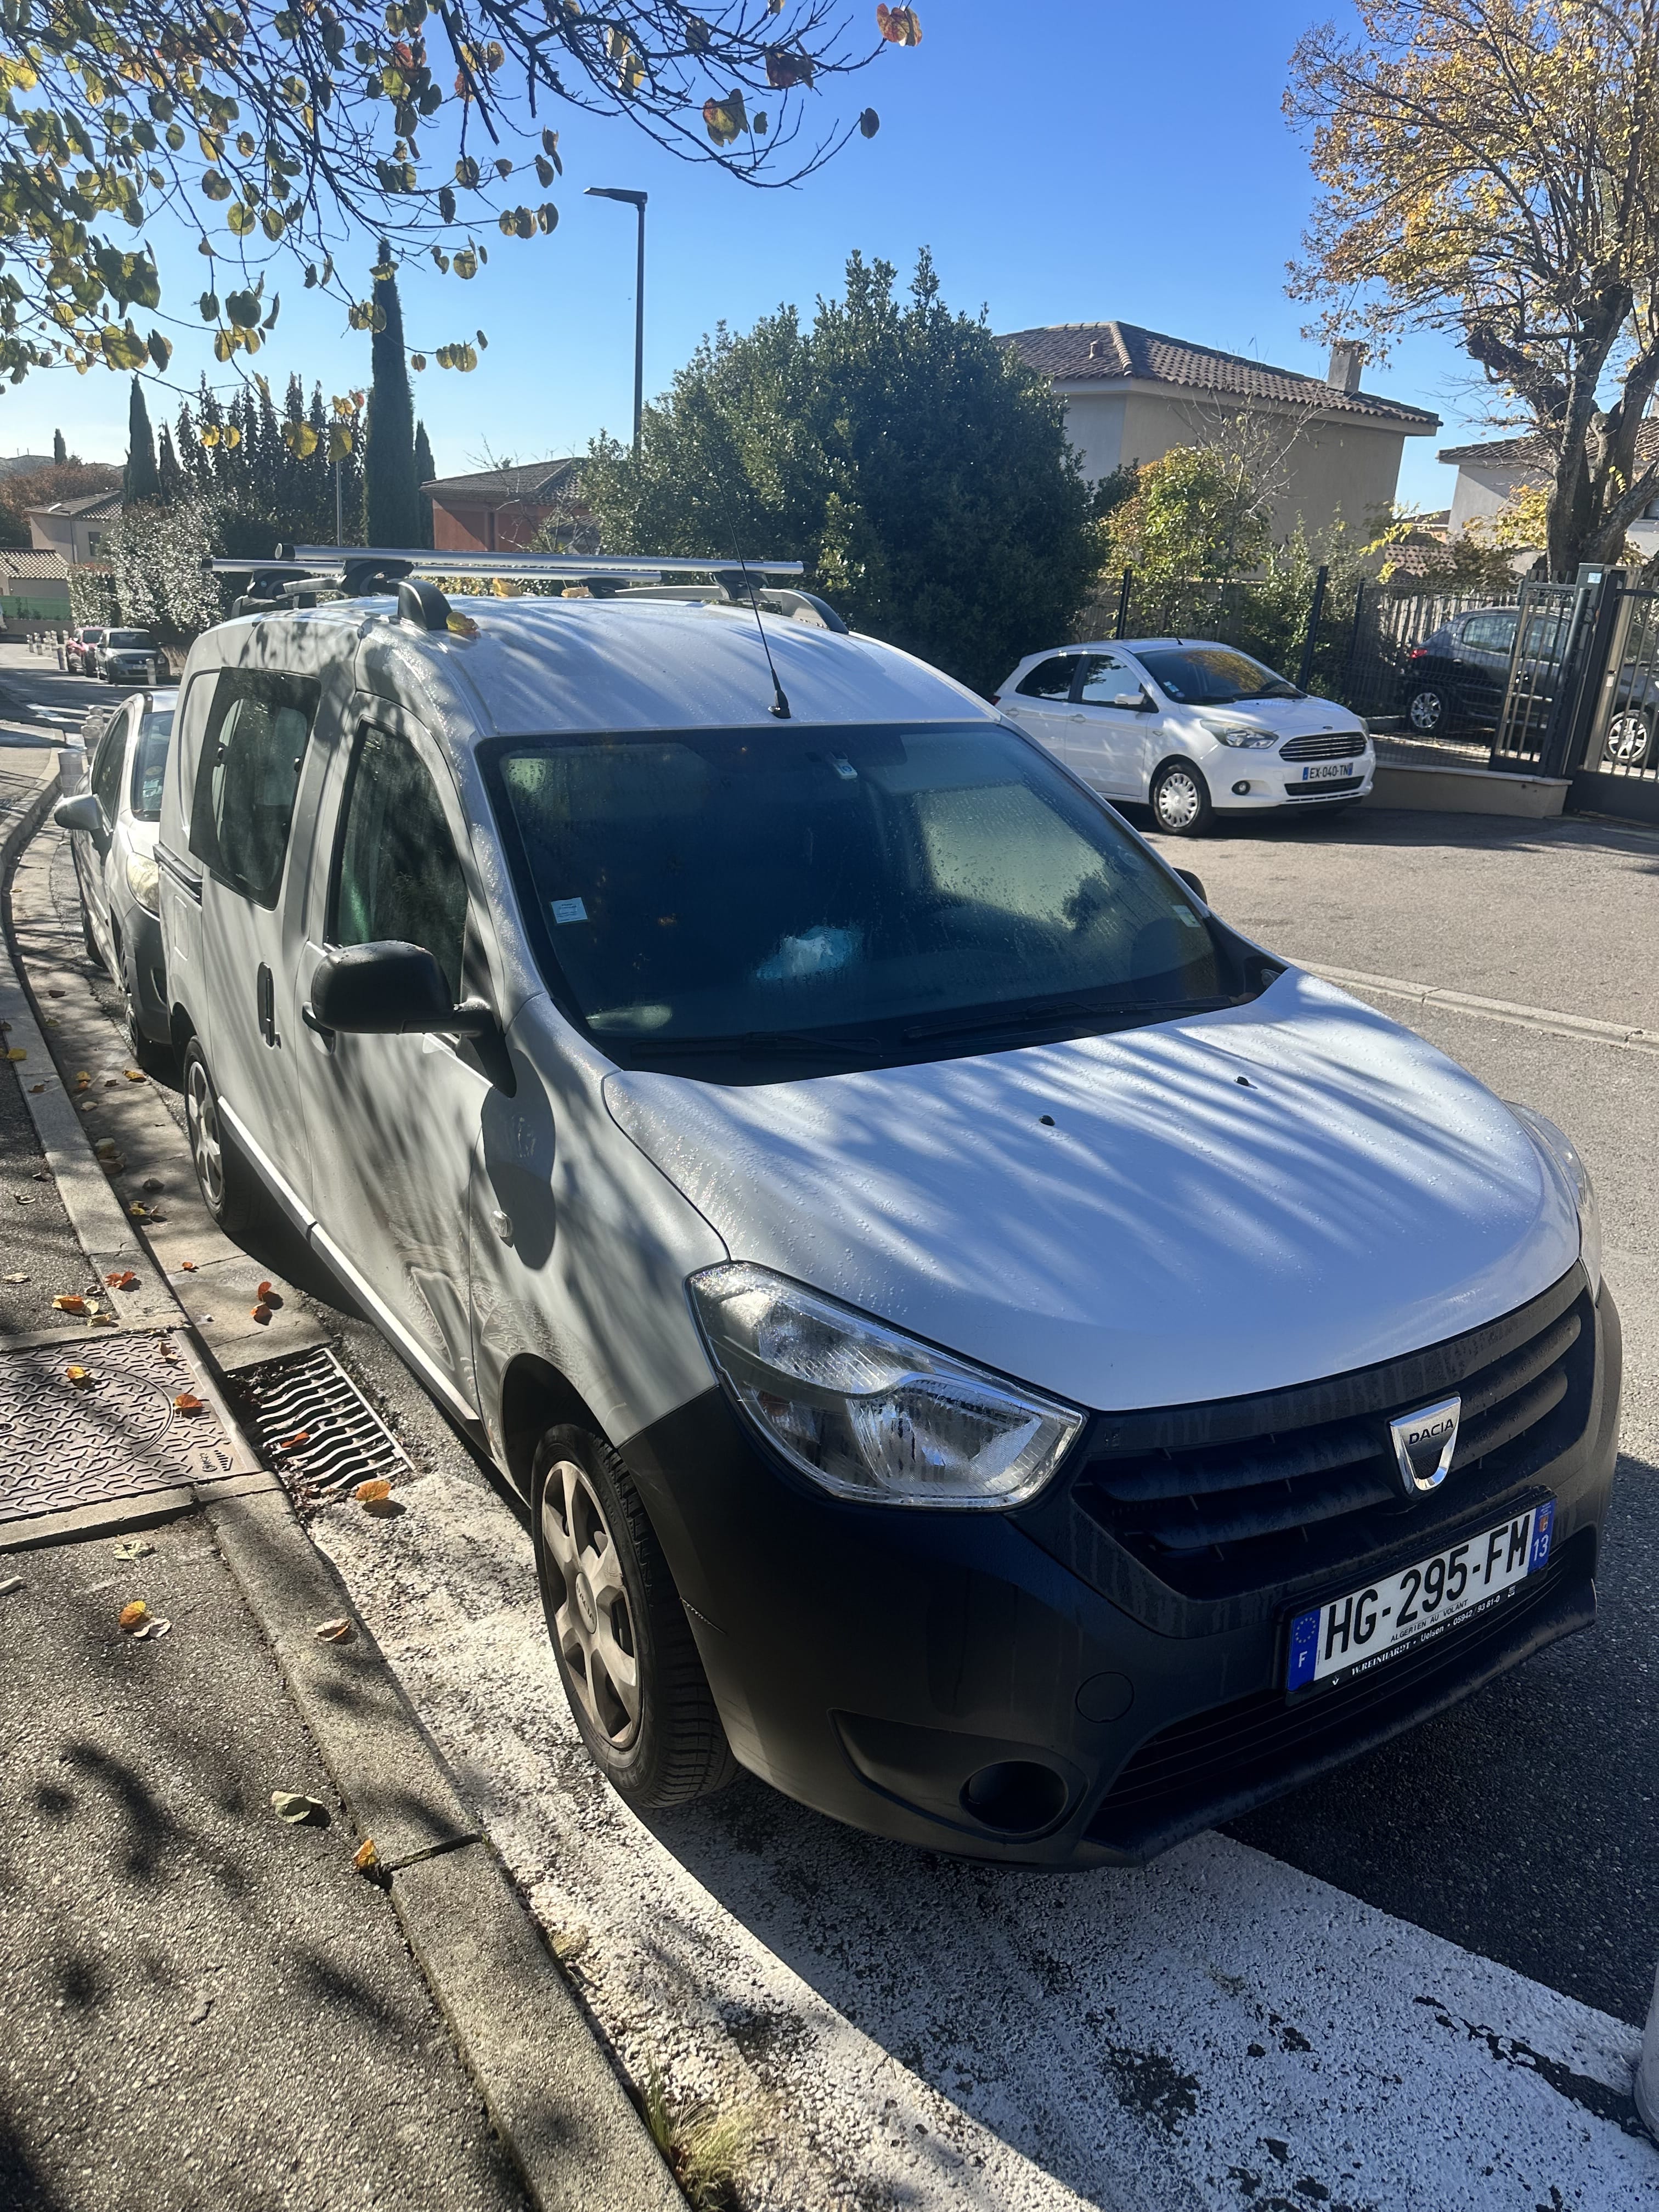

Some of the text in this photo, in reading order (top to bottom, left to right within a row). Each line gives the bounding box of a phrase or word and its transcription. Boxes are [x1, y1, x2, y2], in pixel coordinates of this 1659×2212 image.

[1310, 765, 1348, 778] EX-040-TN
[1409, 1419, 1454, 1445] DACIA
[1534, 1534, 1549, 1561] 13
[1325, 1514, 1530, 1660] HG-295-FM
[1390, 1599, 1469, 1643] ALGERIEN AU VOLANT
[1351, 1641, 1411, 1676] W.REINHARDT
[1453, 1610, 1473, 1626] 05942
[1298, 1650, 1308, 1668] F
